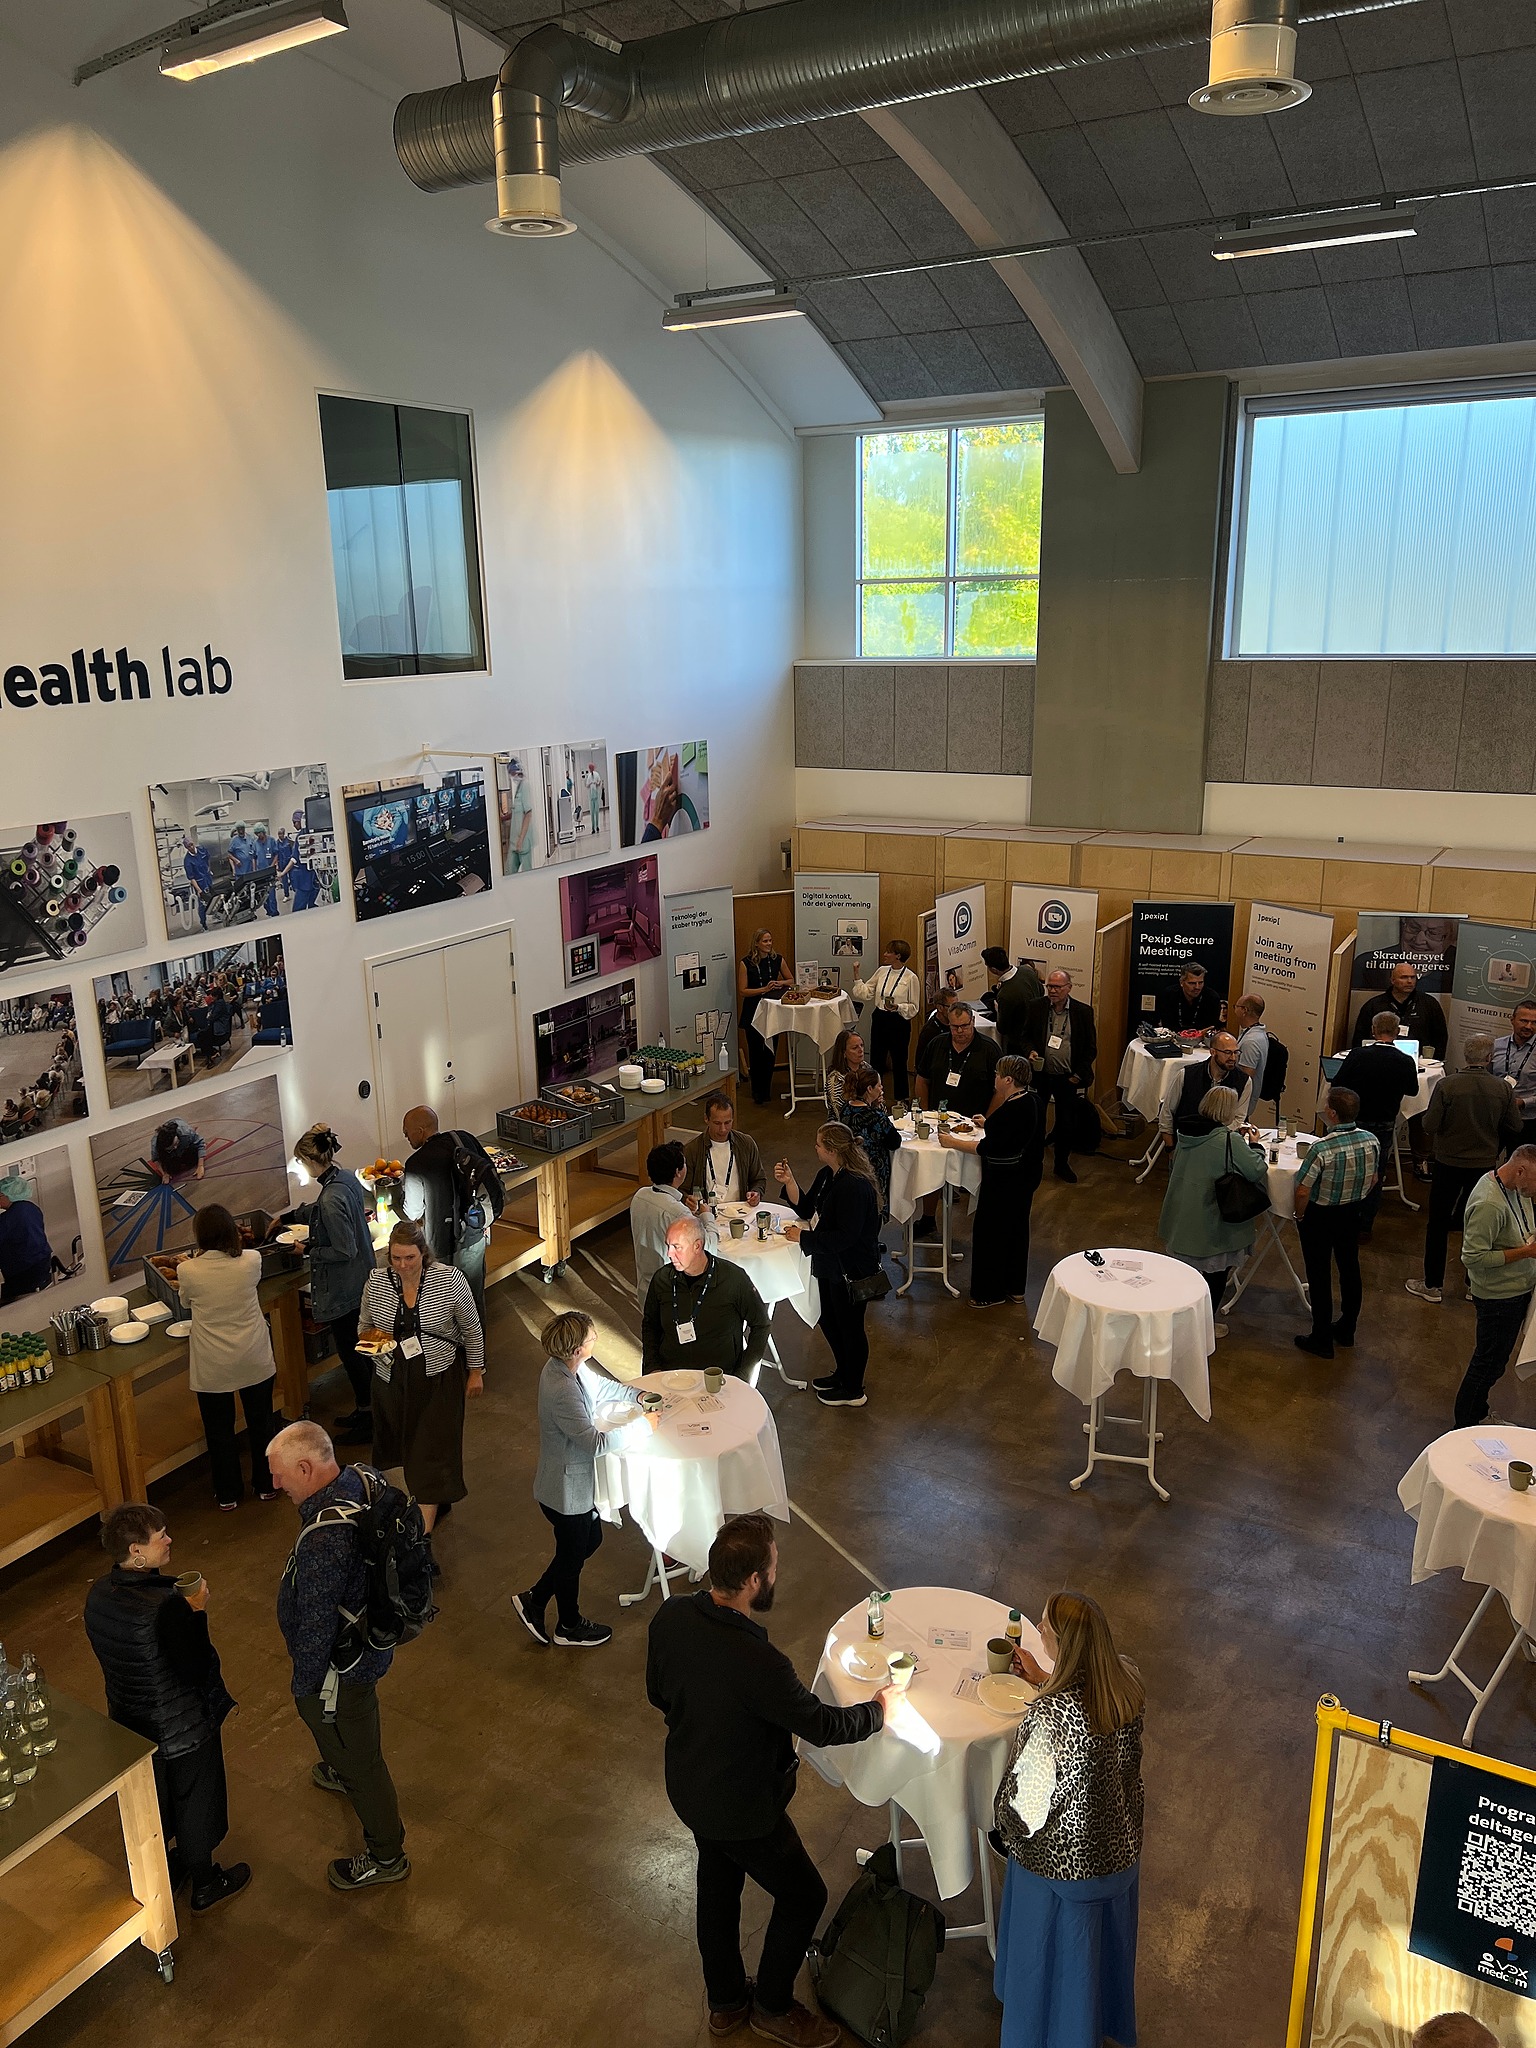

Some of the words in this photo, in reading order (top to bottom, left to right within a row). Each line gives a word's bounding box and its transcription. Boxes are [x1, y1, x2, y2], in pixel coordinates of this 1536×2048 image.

[0, 647, 151, 709] ealth
[162, 644, 234, 697] lab
[406, 850, 426, 864] 15:00
[802, 892, 824, 901] Digital
[827, 900, 845, 909] giver
[845, 900, 872, 910] mening
[671, 911, 698, 922] Teknologi
[698, 910, 708, 918] der
[671, 921, 691, 930] skaber
[691, 917, 713, 928] tryghed
[1025, 937, 1076, 952] VitaComm
[1140, 933, 1172, 946] Pexip
[1173, 934, 1215, 945] Secure
[1255, 935, 1275, 949] Join
[1276, 941, 1294, 954] any
[947, 939, 977, 956] VitaComm
[1139, 945, 1193, 959] Meetings
[1254, 950, 1292, 967] meeting
[1294, 956, 1317, 971] from
[1372, 950, 1445, 963] Skræddersyet
[1253, 962, 1270, 975] any
[1271, 966, 1296, 979] room
[1365, 960, 1377, 969] til
[1379, 961, 1396, 970] din
[1404, 961, 1451, 973] orgeres
[1467, 1006, 1498, 1018] TRYGHED
[1478, 1795, 1536, 1826] Progra
[1477, 1964, 1528, 1989] medcom
